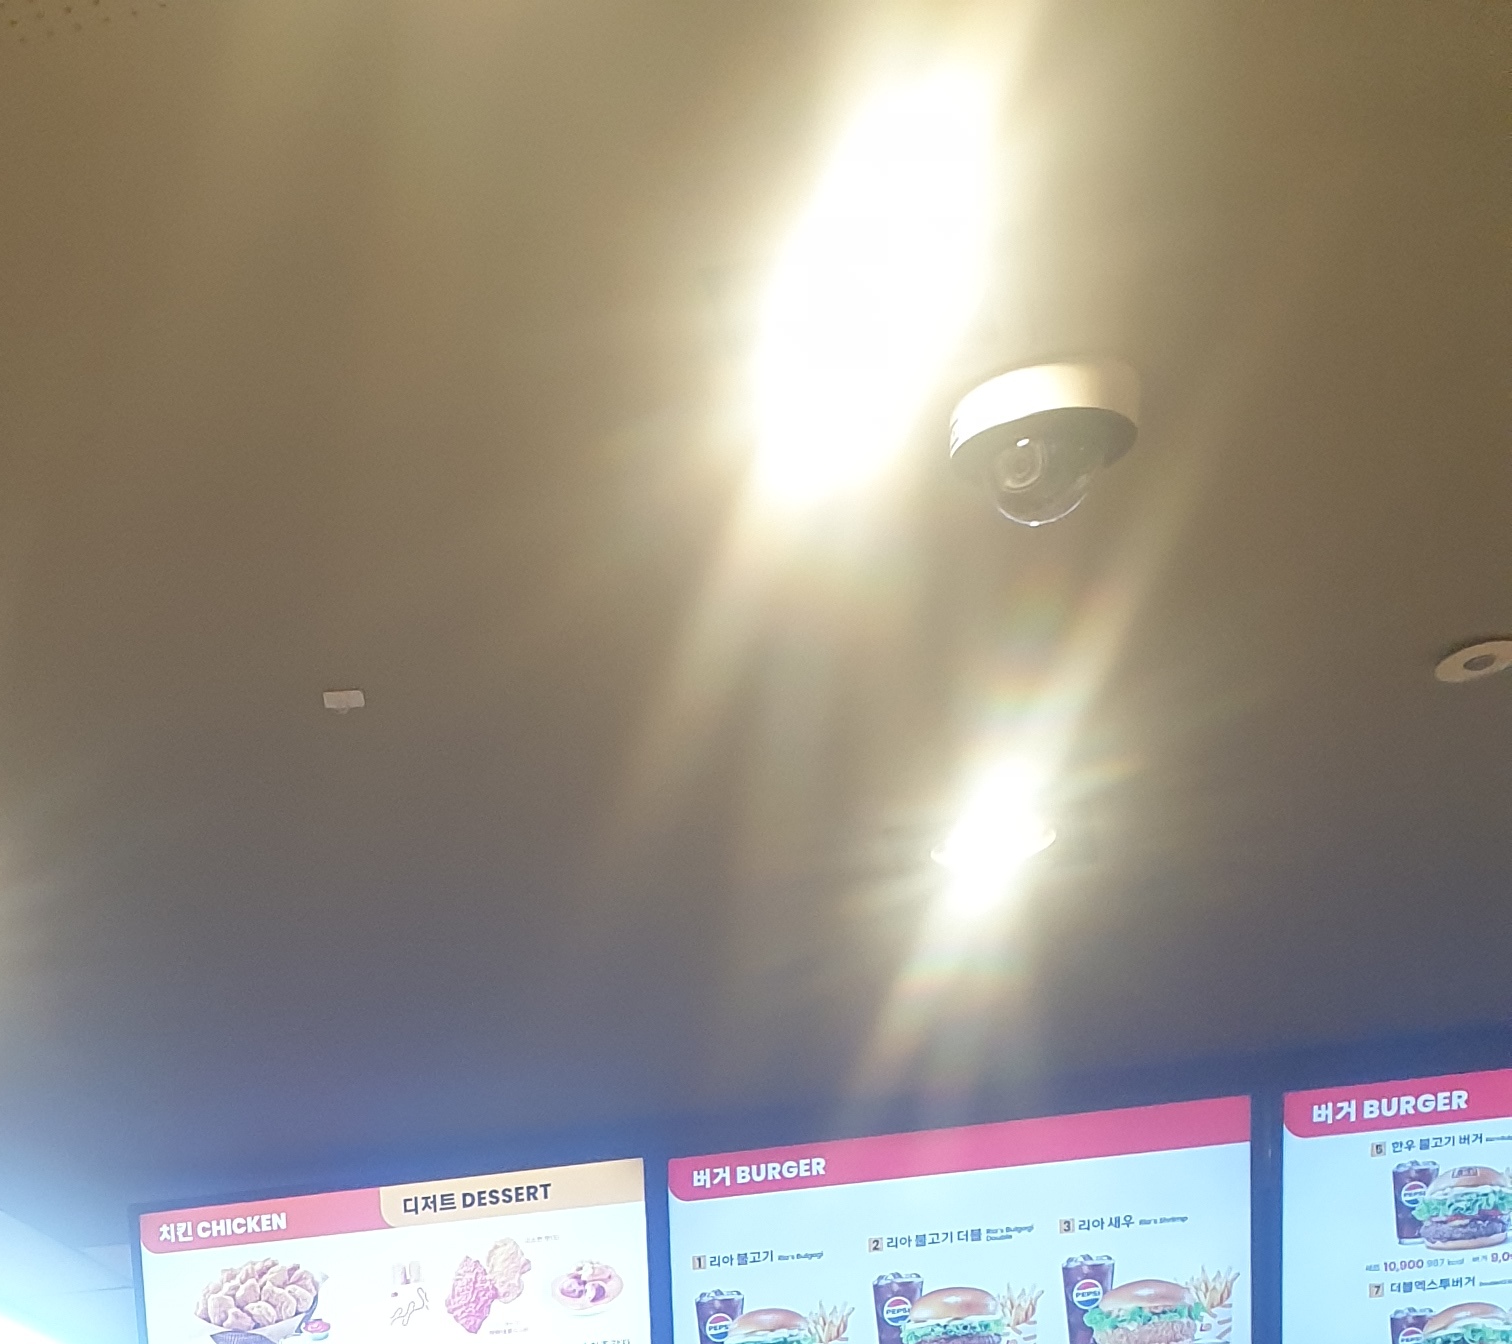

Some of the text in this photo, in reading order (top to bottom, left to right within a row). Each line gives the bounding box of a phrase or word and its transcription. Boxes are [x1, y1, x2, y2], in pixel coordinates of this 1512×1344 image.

[1312, 1090, 1468, 1124] 버거 BURGER
[1392, 1139, 1416, 1153] 한우
[1419, 1136, 1455, 1150] 불고기
[1459, 1133, 1483, 1145] 버거
[693, 1157, 825, 1189] 버거 BURGER
[403, 1183, 552, 1216] 디저트 DESSERT
[159, 1212, 287, 1243] 치킨 CHICKEN
[1078, 1217, 1105, 1231] 리아
[1107, 1214, 1135, 1229] 새우
[887, 1235, 912, 1248] 리아
[915, 1231, 953, 1247] 불고기
[709, 1254, 734, 1267] 리아
[737, 1250, 774, 1266] 불고기
[1075, 1290, 1101, 1298] PEPSI
[708, 1324, 729, 1332] PEPS
